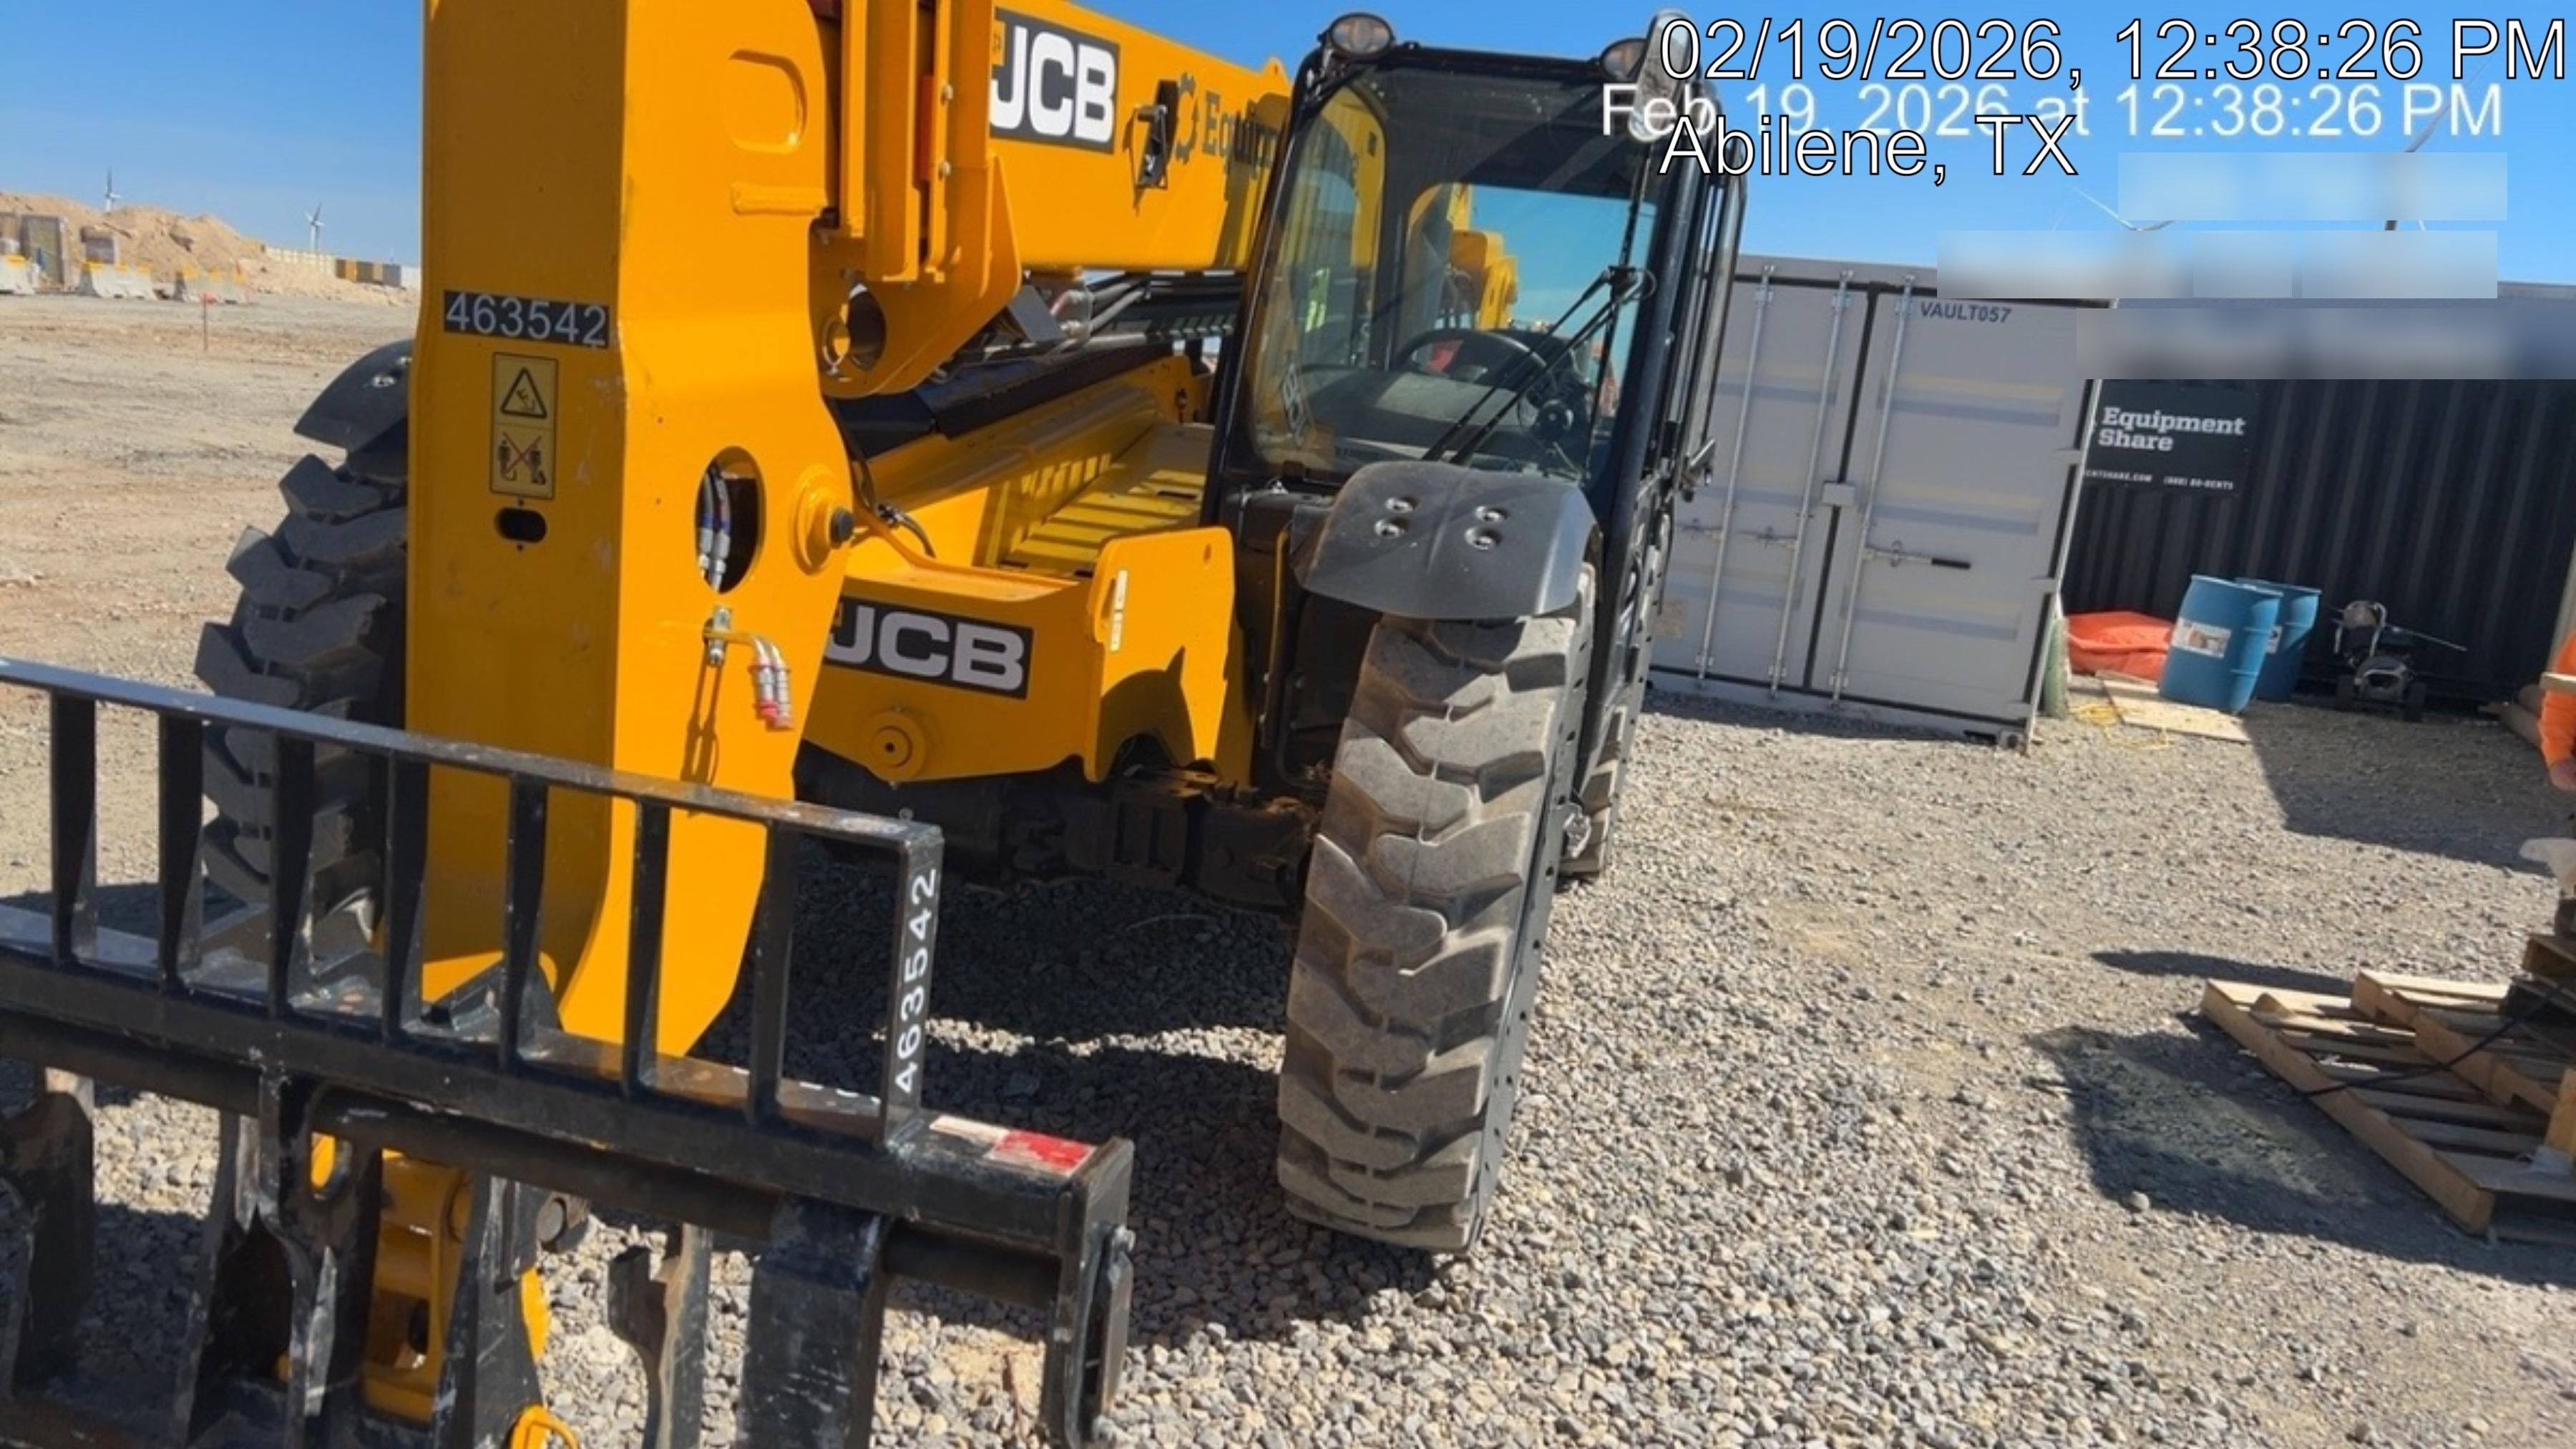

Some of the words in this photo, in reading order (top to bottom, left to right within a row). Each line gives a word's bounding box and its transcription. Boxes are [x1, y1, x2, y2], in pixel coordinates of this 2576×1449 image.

[988, 26, 1116, 143] JCB
[445, 291, 608, 350] 463542
[1920, 300, 2013, 324] VAULT057
[2097, 428, 2174, 452] Share
[2102, 406, 2247, 436] Equipment
[825, 605, 1026, 691] JCB
[895, 868, 938, 1095] 463542
